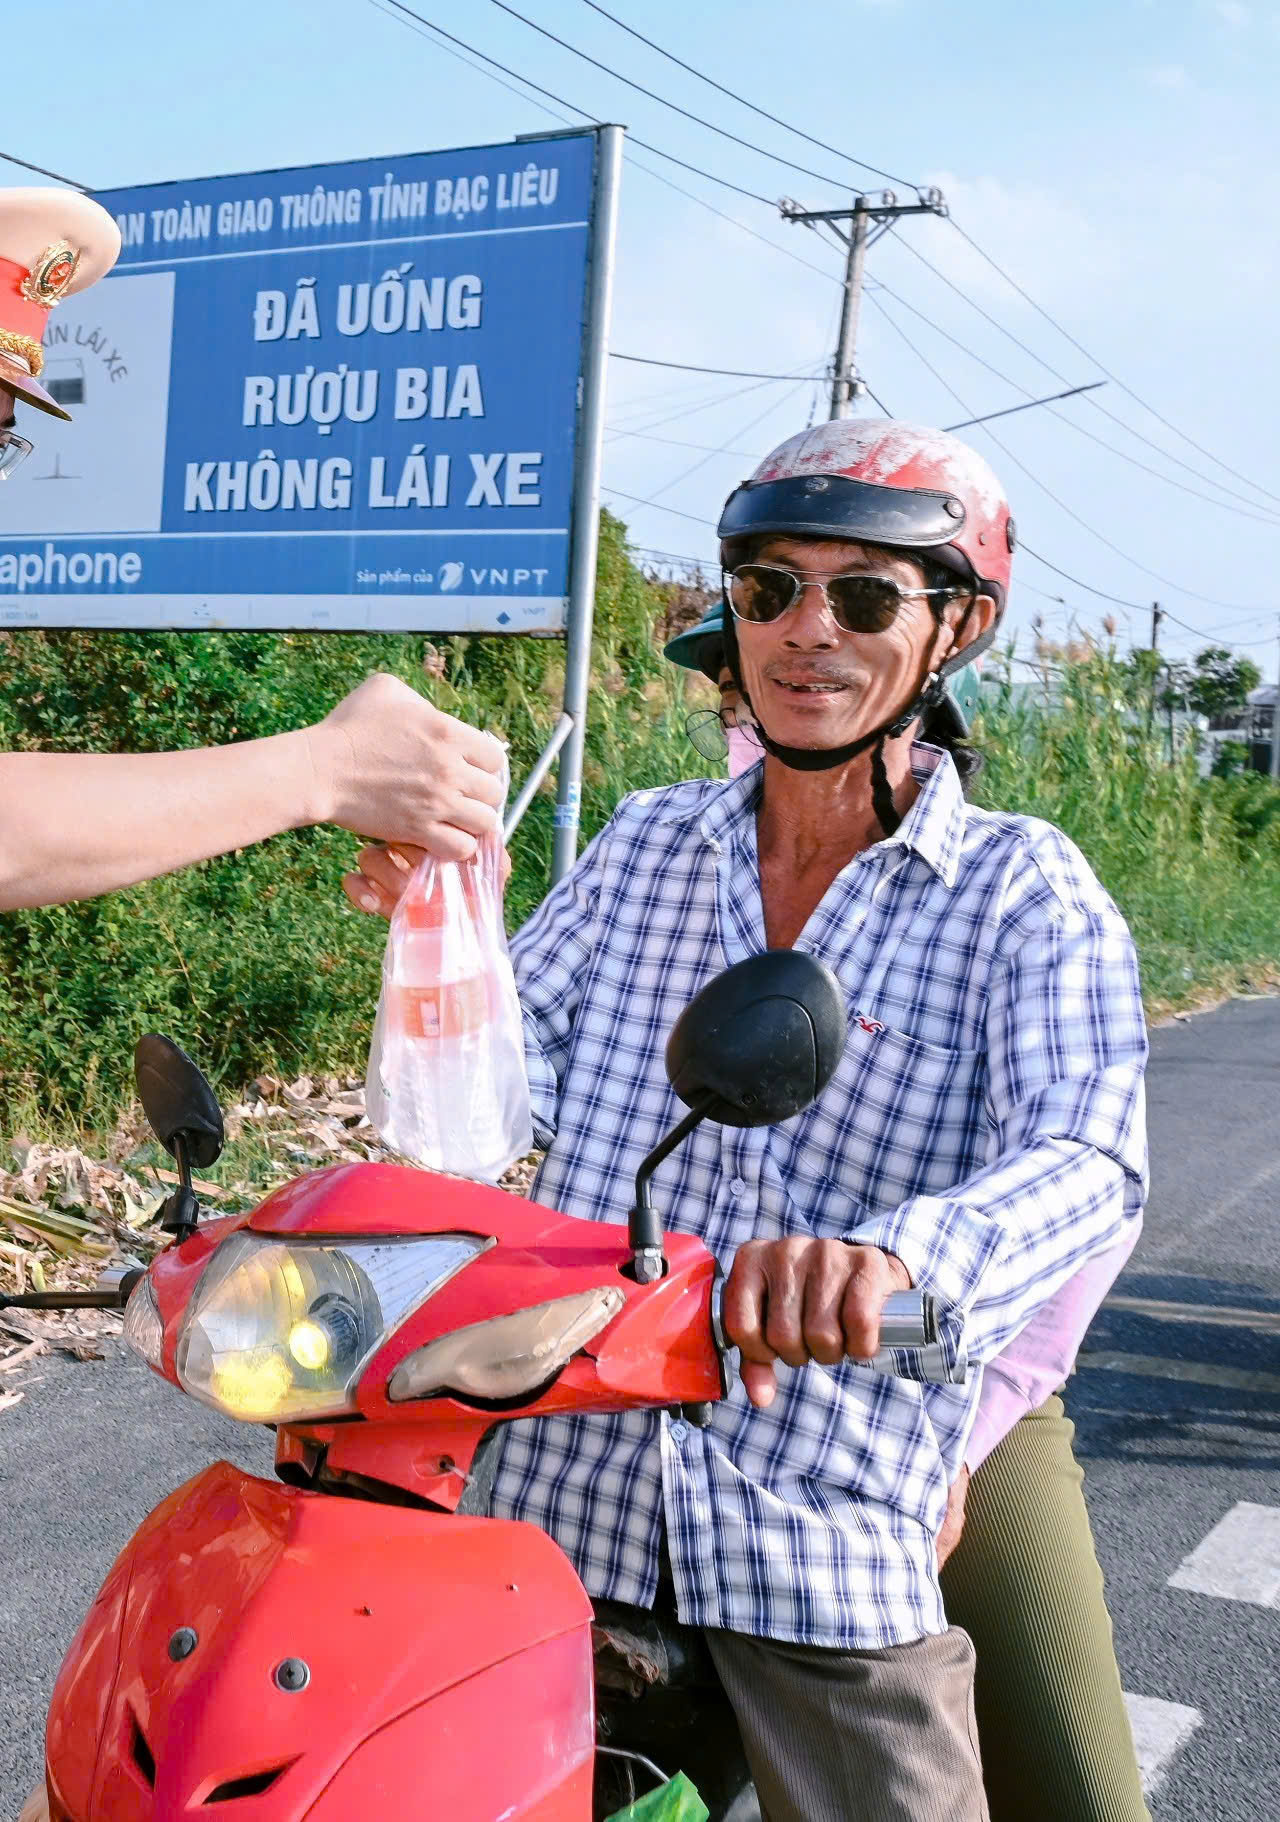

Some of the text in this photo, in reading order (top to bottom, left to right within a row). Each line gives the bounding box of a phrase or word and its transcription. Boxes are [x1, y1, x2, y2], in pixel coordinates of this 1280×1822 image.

[152, 201, 211, 242] TOÀN
[218, 198, 273, 235] GIAO
[280, 185, 362, 230] THÔNG
[369, 173, 428, 221] TỈNH
[435, 175, 489, 220] BẠC
[496, 163, 559, 209] LIÊU
[254, 262, 483, 342] ĐÃ UỐNG
[75, 324, 108, 354] LÁI
[102, 348, 128, 383] XE
[243, 363, 485, 435] RƯỢU BIA
[184, 443, 543, 512] KHÔNG LÁI XE
[357, 567, 433, 585] Sản phẩm của
[470, 568, 549, 585] VNPT
